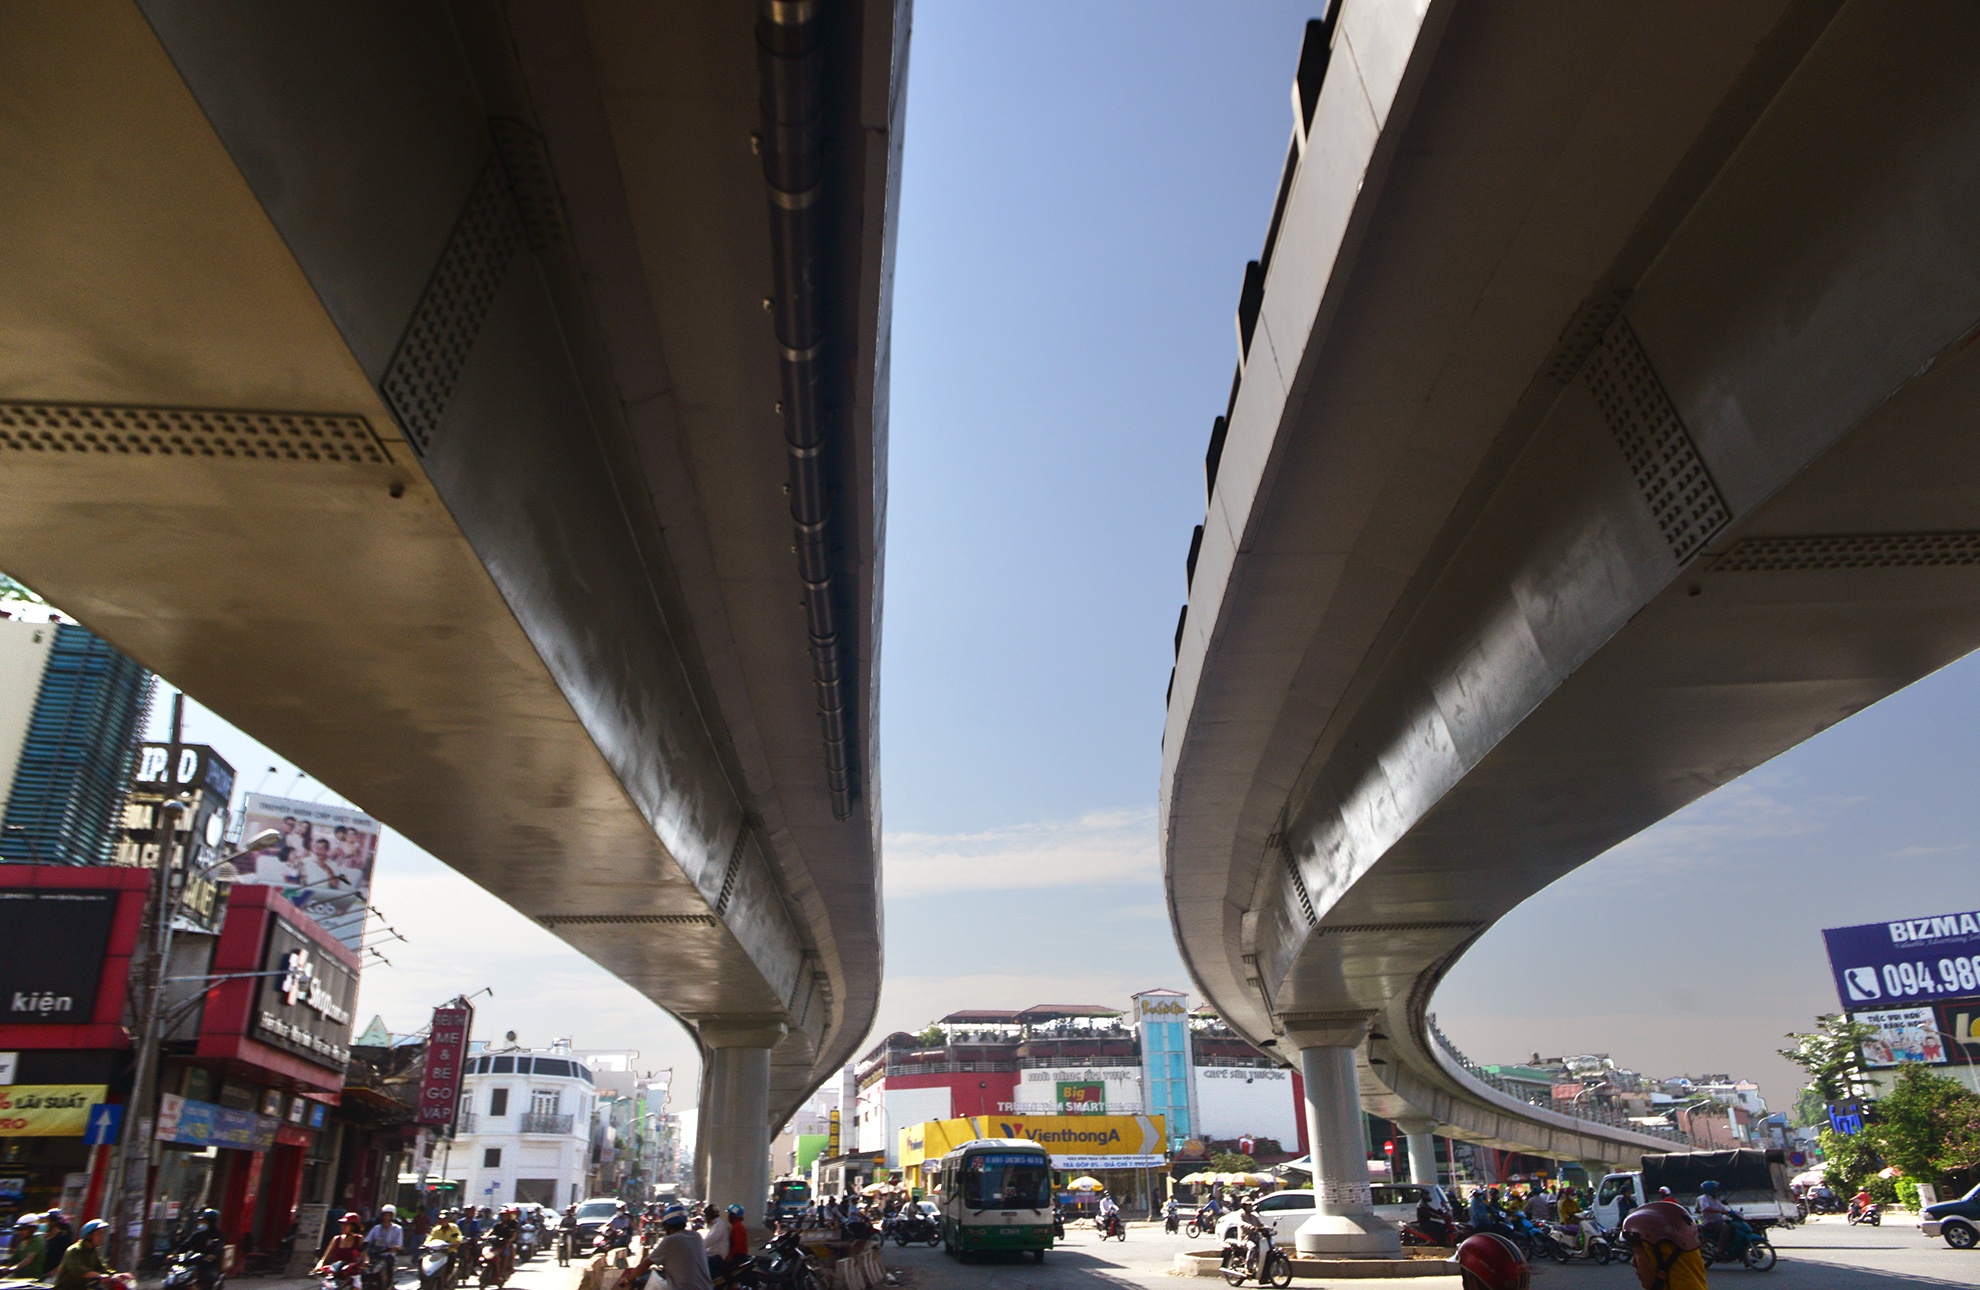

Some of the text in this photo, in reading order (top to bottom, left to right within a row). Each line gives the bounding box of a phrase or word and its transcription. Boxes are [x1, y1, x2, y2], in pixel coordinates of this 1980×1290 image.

[11, 992, 73, 1017] kiện
[1063, 1086, 1085, 1100] Big
[1025, 1129, 1120, 1145] VienthongA
